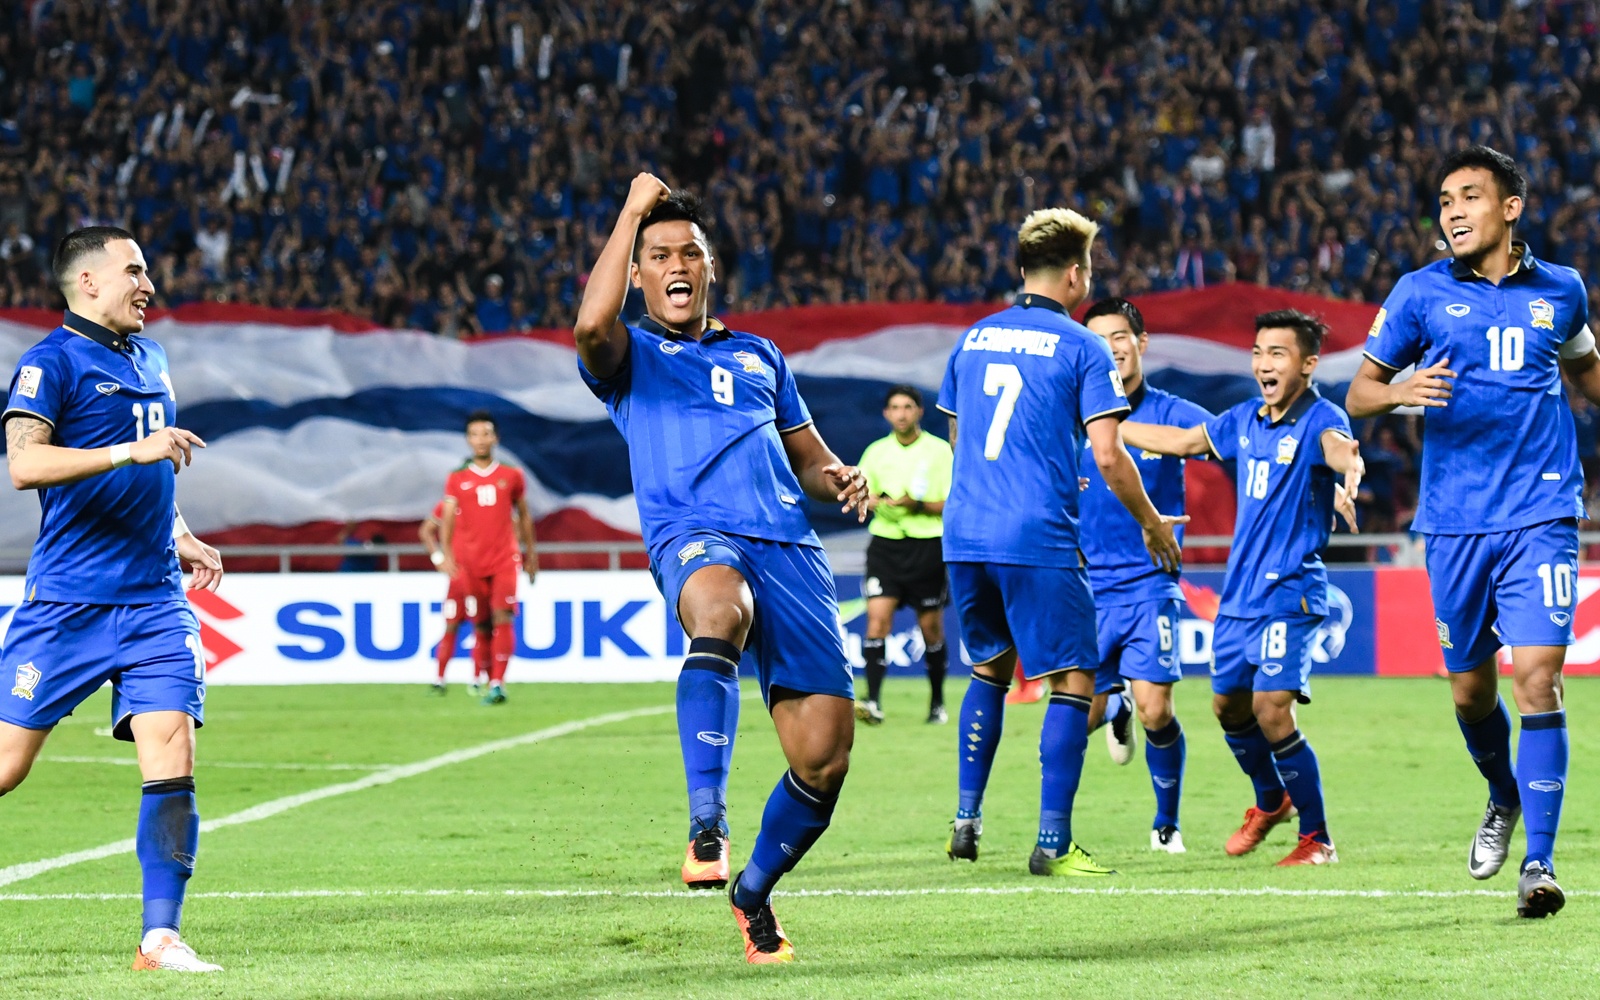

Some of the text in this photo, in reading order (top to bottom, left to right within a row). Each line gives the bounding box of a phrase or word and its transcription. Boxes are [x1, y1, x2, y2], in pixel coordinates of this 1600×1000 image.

[1486, 326, 1525, 371] 10
[711, 365, 734, 406] 9
[132, 402, 165, 441] 19
[983, 362, 1023, 460] 7
[1246, 459, 1269, 499] 18
[1537, 563, 1572, 607] 10
[1157, 615, 1173, 651] 6
[1260, 621, 1287, 660] 18
